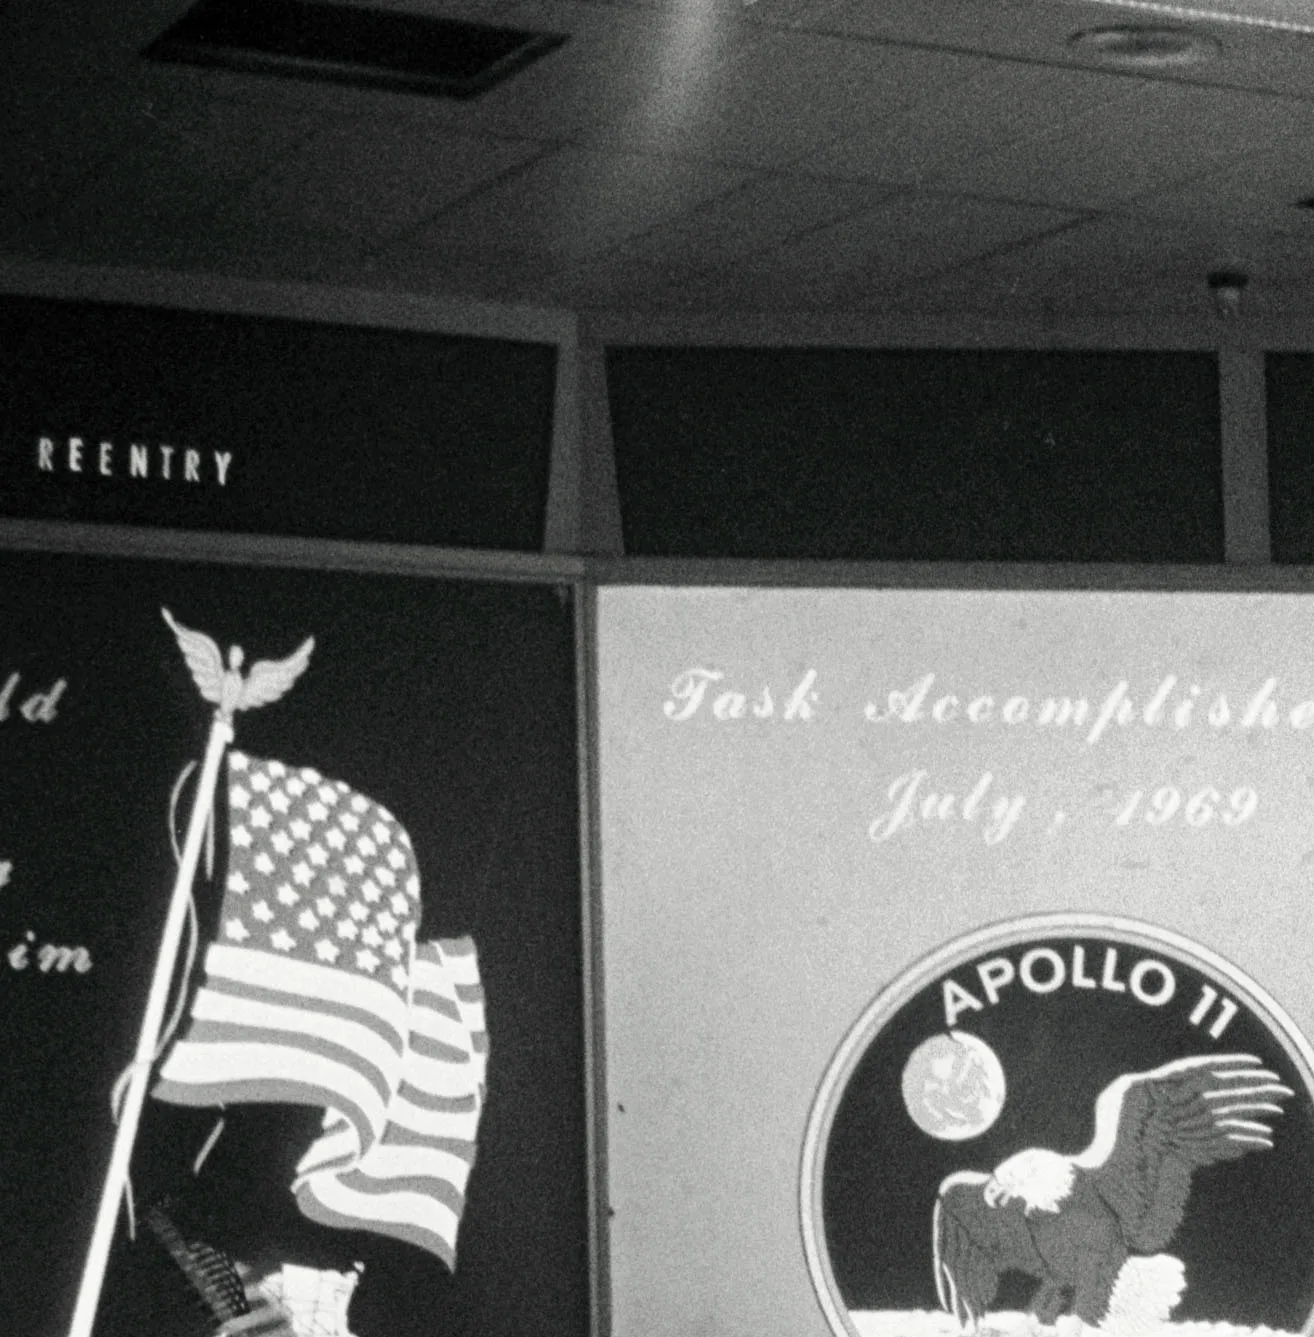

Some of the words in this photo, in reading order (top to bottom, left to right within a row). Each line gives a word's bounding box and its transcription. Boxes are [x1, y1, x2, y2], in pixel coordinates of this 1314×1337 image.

[38, 437, 233, 485] REENTRY
[663, 668, 820, 721] Task
[1116, 786, 1258, 827] 1969
[943, 945, 1177, 1027] APOLLO
[1189, 984, 1238, 1040] 11
